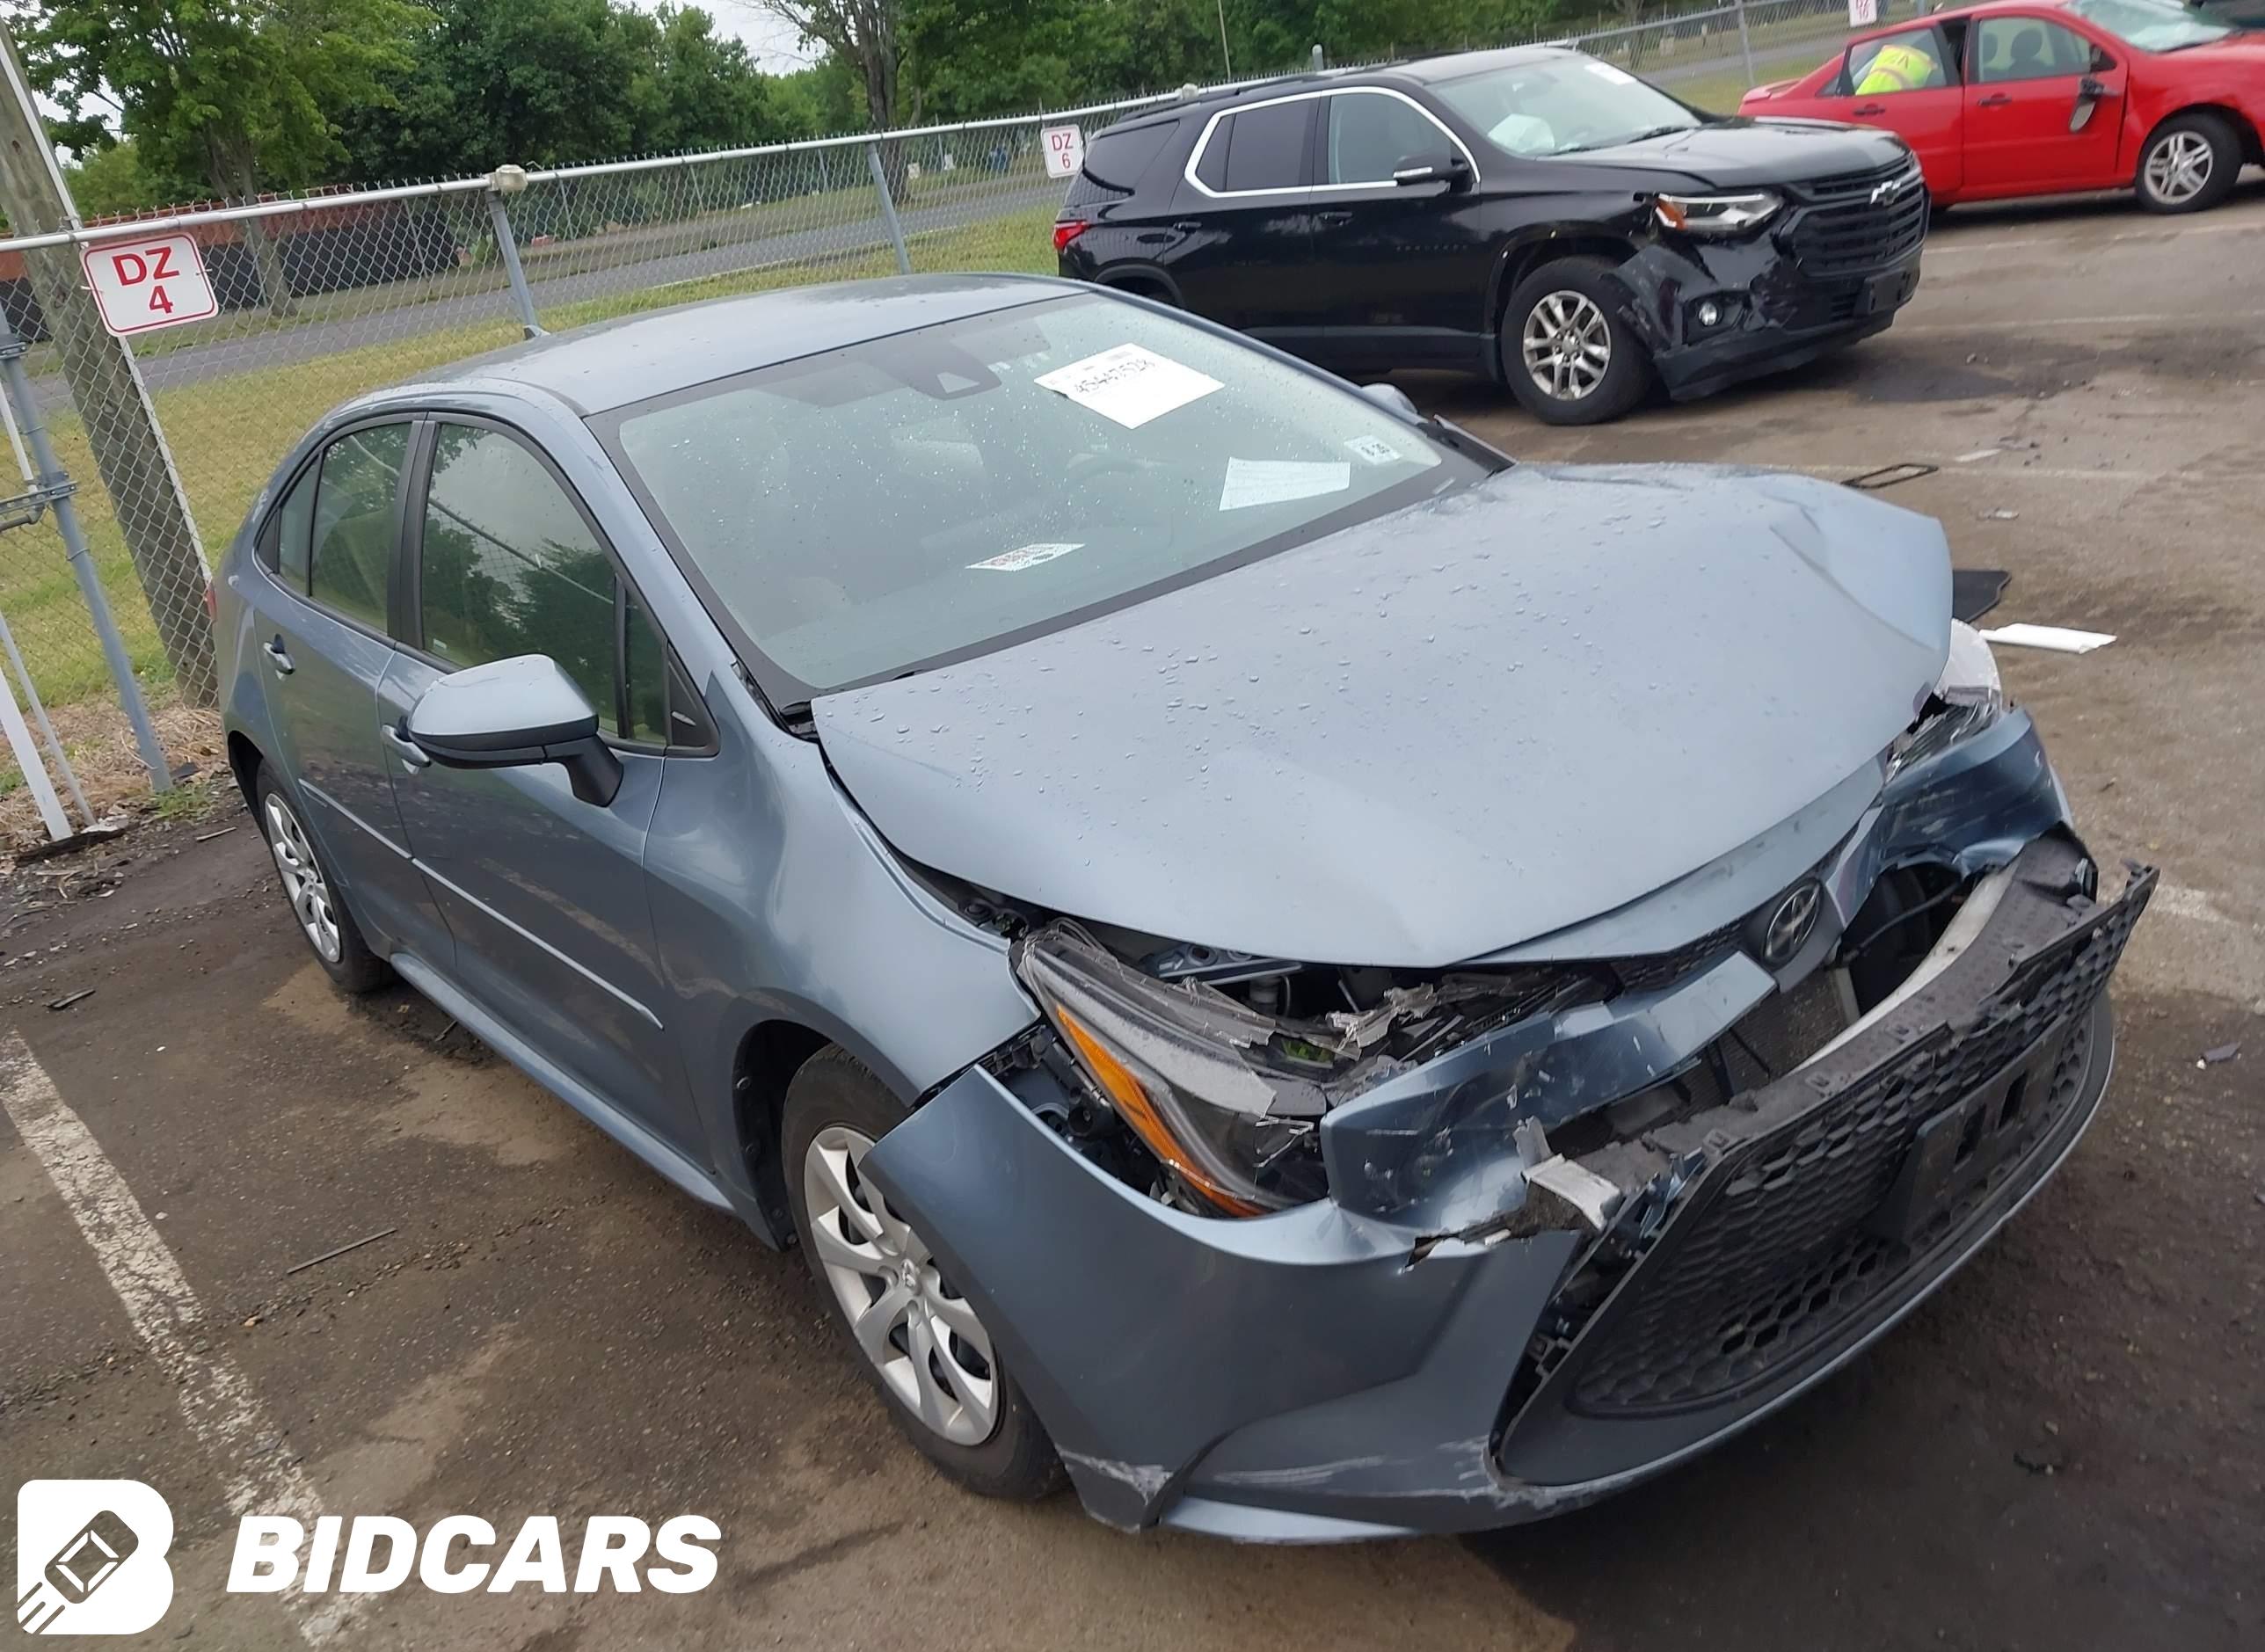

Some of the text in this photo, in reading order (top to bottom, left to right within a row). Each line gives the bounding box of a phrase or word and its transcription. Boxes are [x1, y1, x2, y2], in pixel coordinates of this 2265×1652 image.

[1052, 133, 1073, 151] DZ
[1061, 152, 1071, 169] 6
[112, 246, 179, 287] DZ
[149, 286, 174, 314] 4
